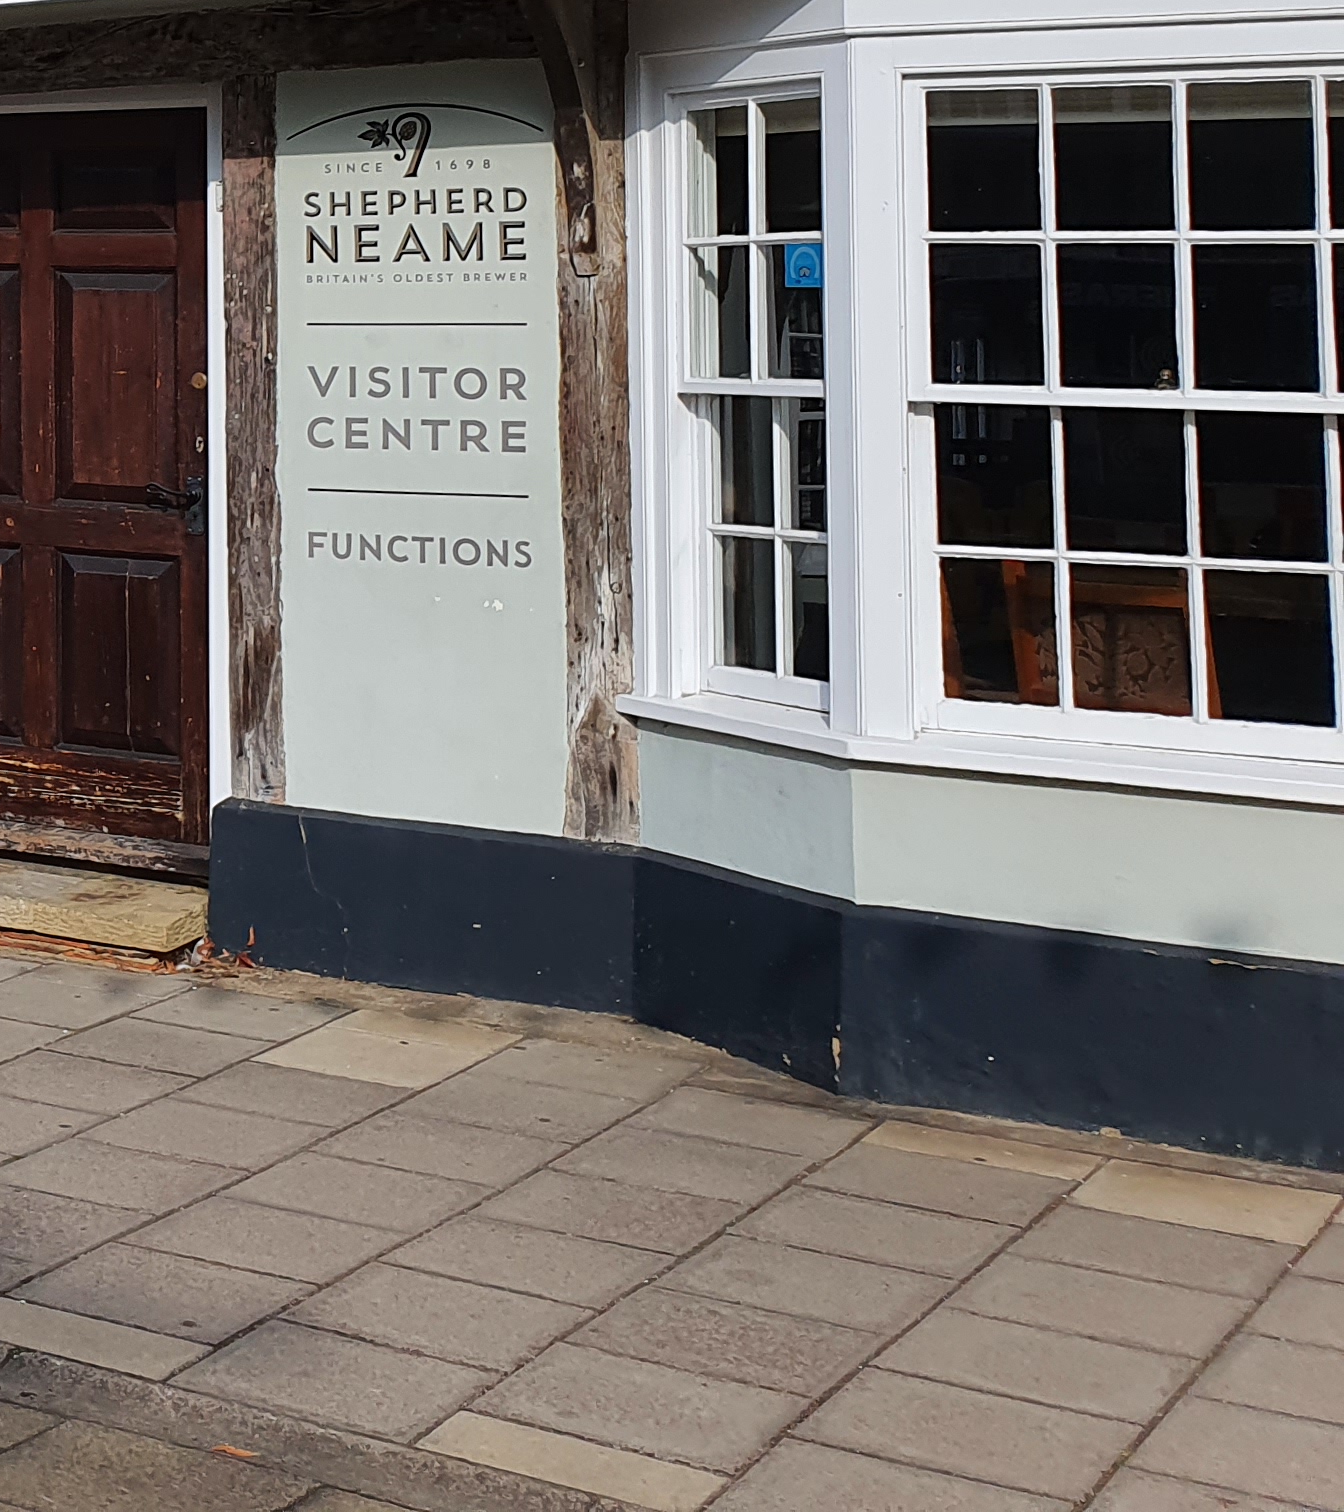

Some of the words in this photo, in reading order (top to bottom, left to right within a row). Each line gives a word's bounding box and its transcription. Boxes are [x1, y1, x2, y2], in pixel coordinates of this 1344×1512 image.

[324, 162, 383, 174] SINCE
[435, 158, 492, 171] 1698
[303, 187, 528, 218] SHEPHERD
[304, 220, 528, 264] NEAME
[306, 273, 384, 284] BRITAIN'S
[392, 272, 455, 283] OLDEST
[463, 271, 528, 282] BREWER
[307, 365, 528, 401] VISITOR
[307, 416, 528, 454] CENTRE
[307, 531, 533, 569] FUNCTIONS
